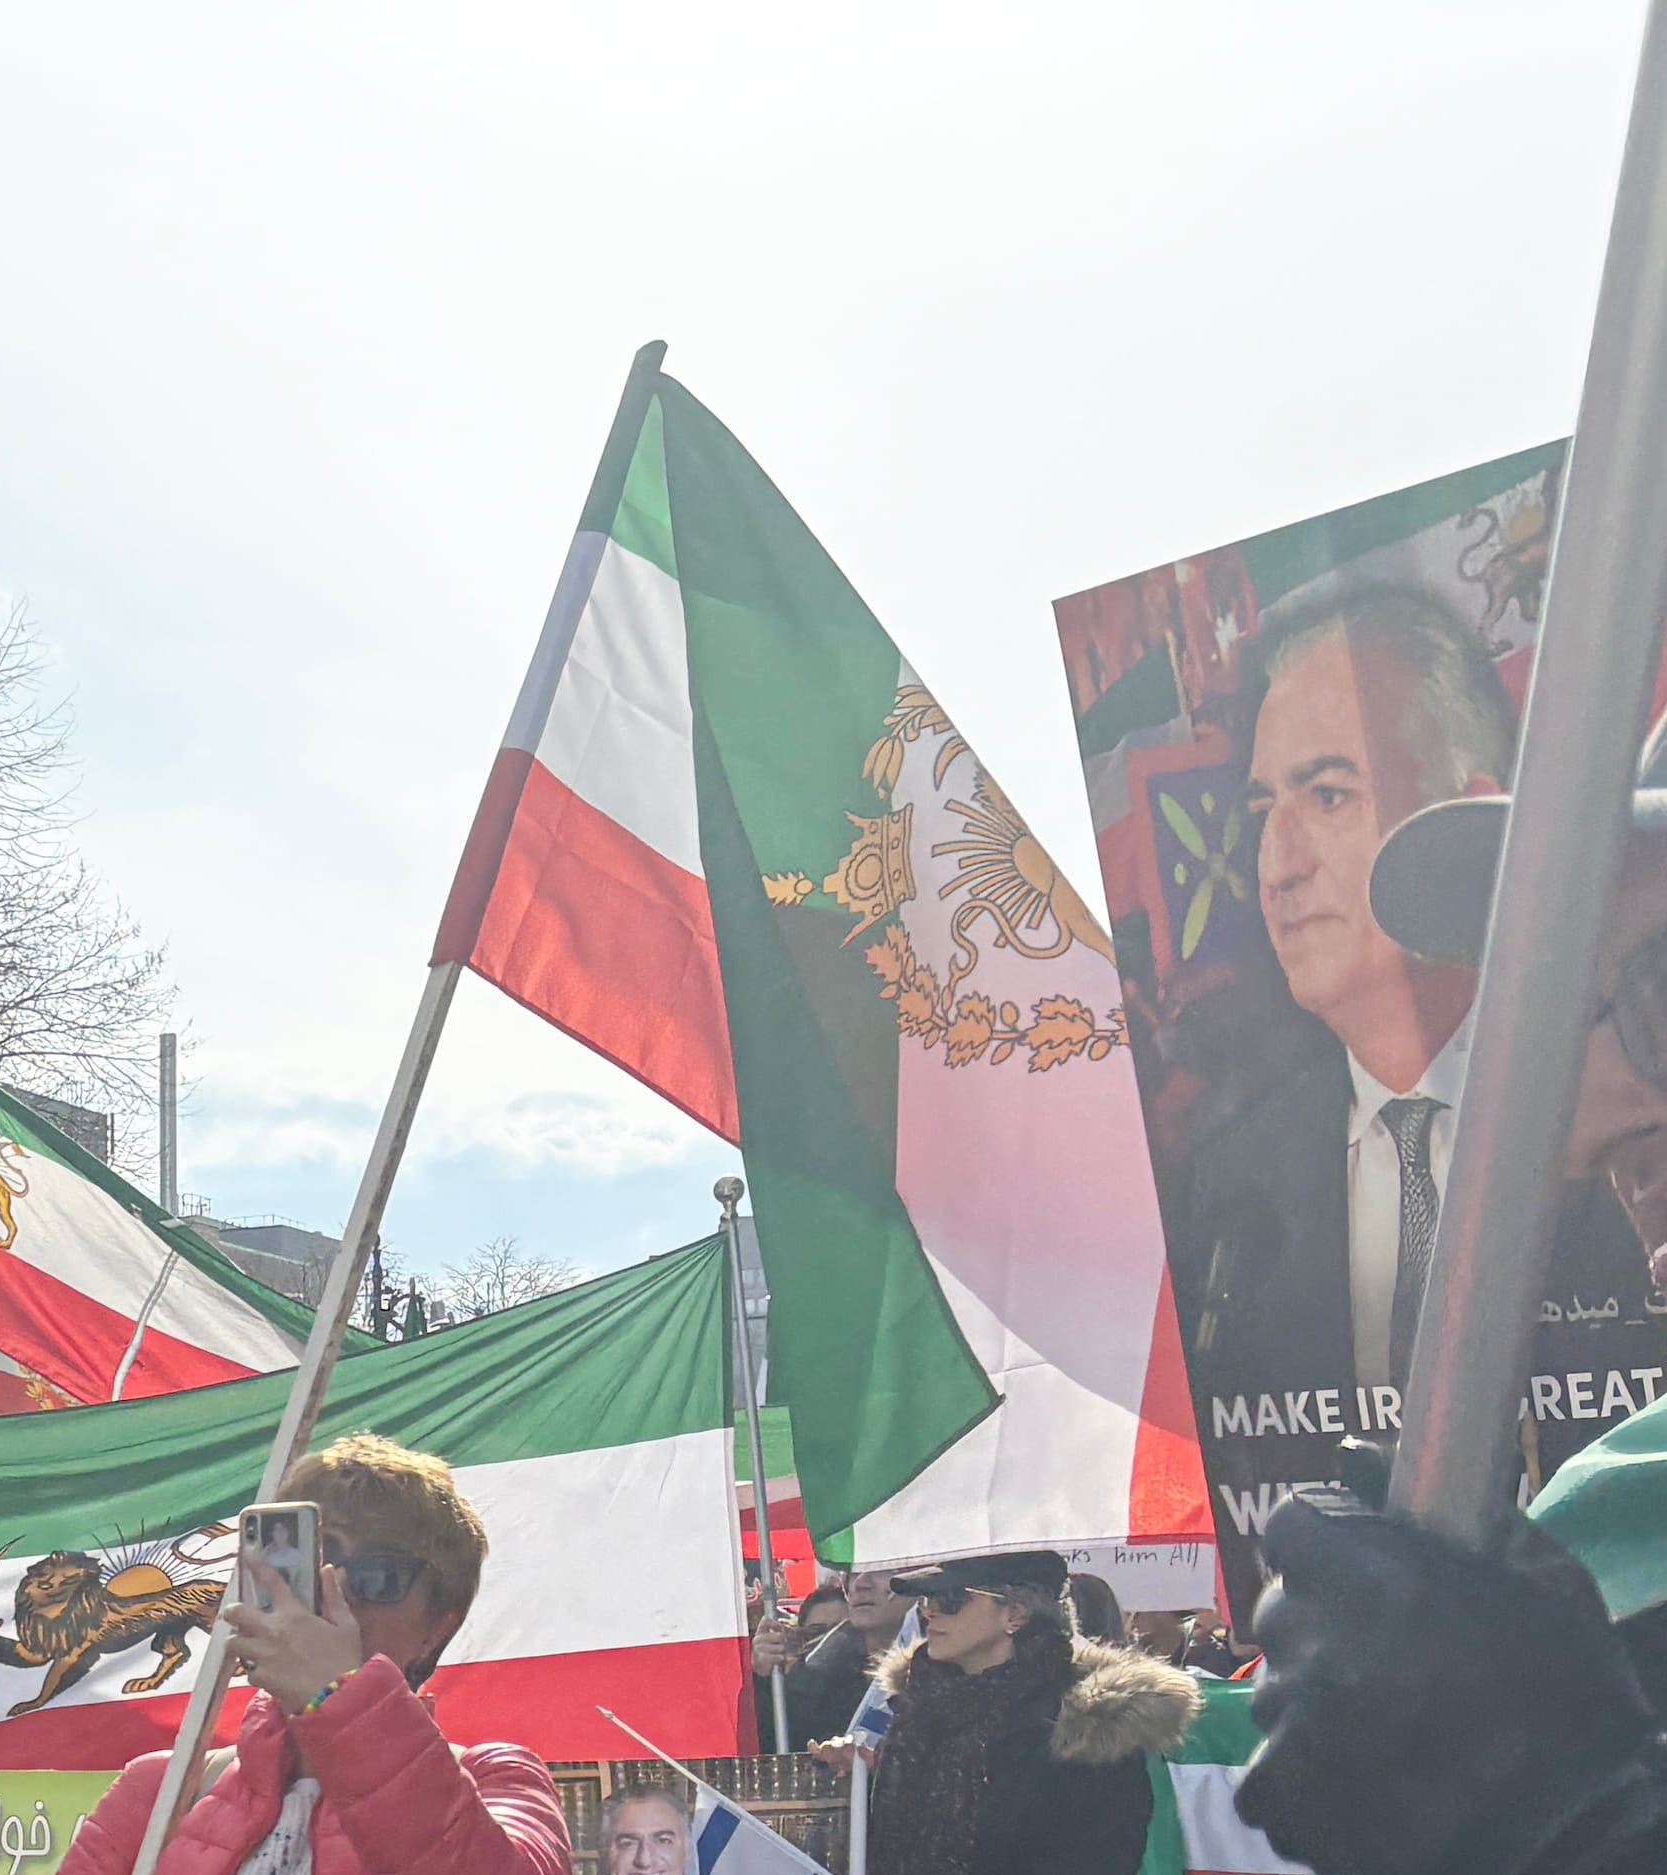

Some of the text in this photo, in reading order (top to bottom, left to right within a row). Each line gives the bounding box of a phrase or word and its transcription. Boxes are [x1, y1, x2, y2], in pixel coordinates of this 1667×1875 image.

[1212, 1367, 1663, 1438] MAKE IR REAT
